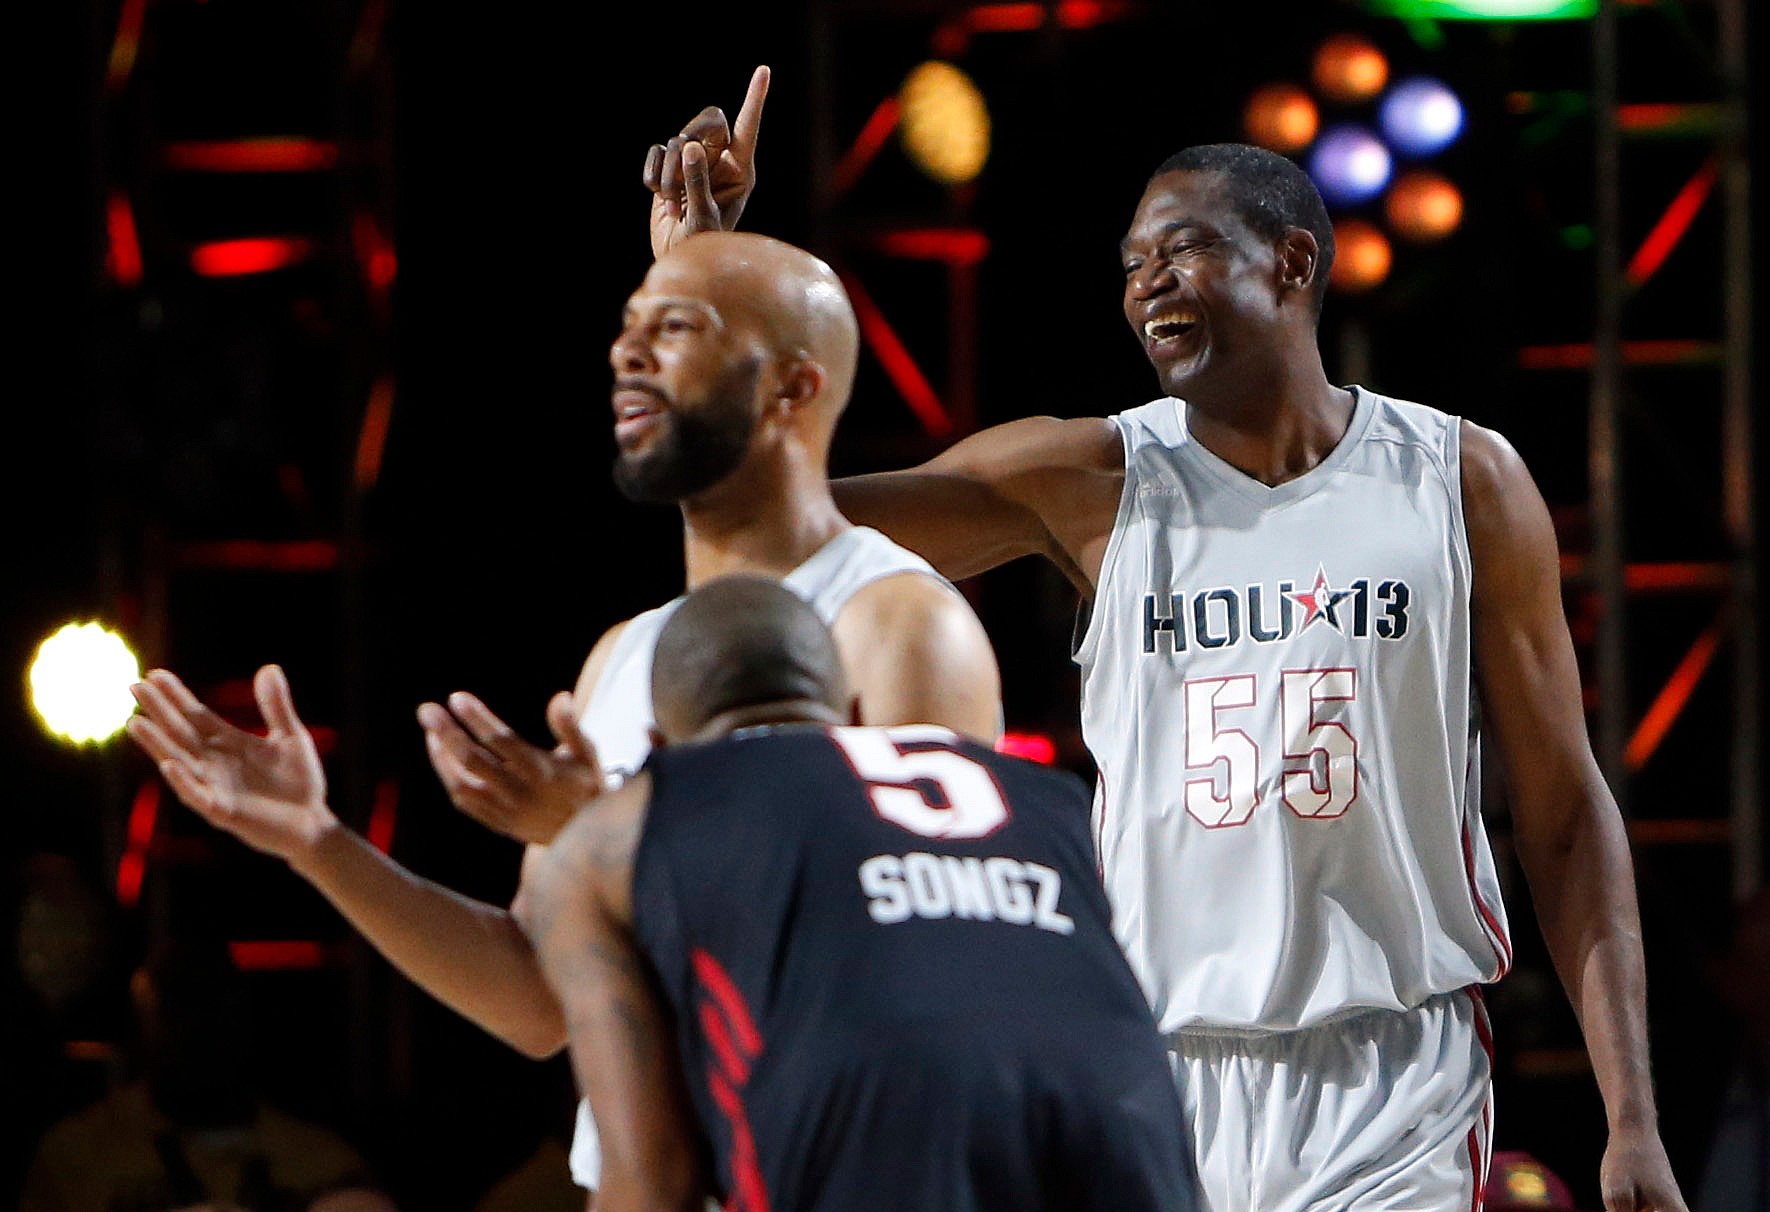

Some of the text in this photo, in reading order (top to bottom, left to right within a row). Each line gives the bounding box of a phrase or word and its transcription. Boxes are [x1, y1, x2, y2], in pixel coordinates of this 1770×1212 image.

[1142, 577, 1411, 656] HOU 13
[825, 723, 1012, 841] 5
[1184, 668, 1358, 830] 55
[858, 851, 1076, 936] SONGZ
